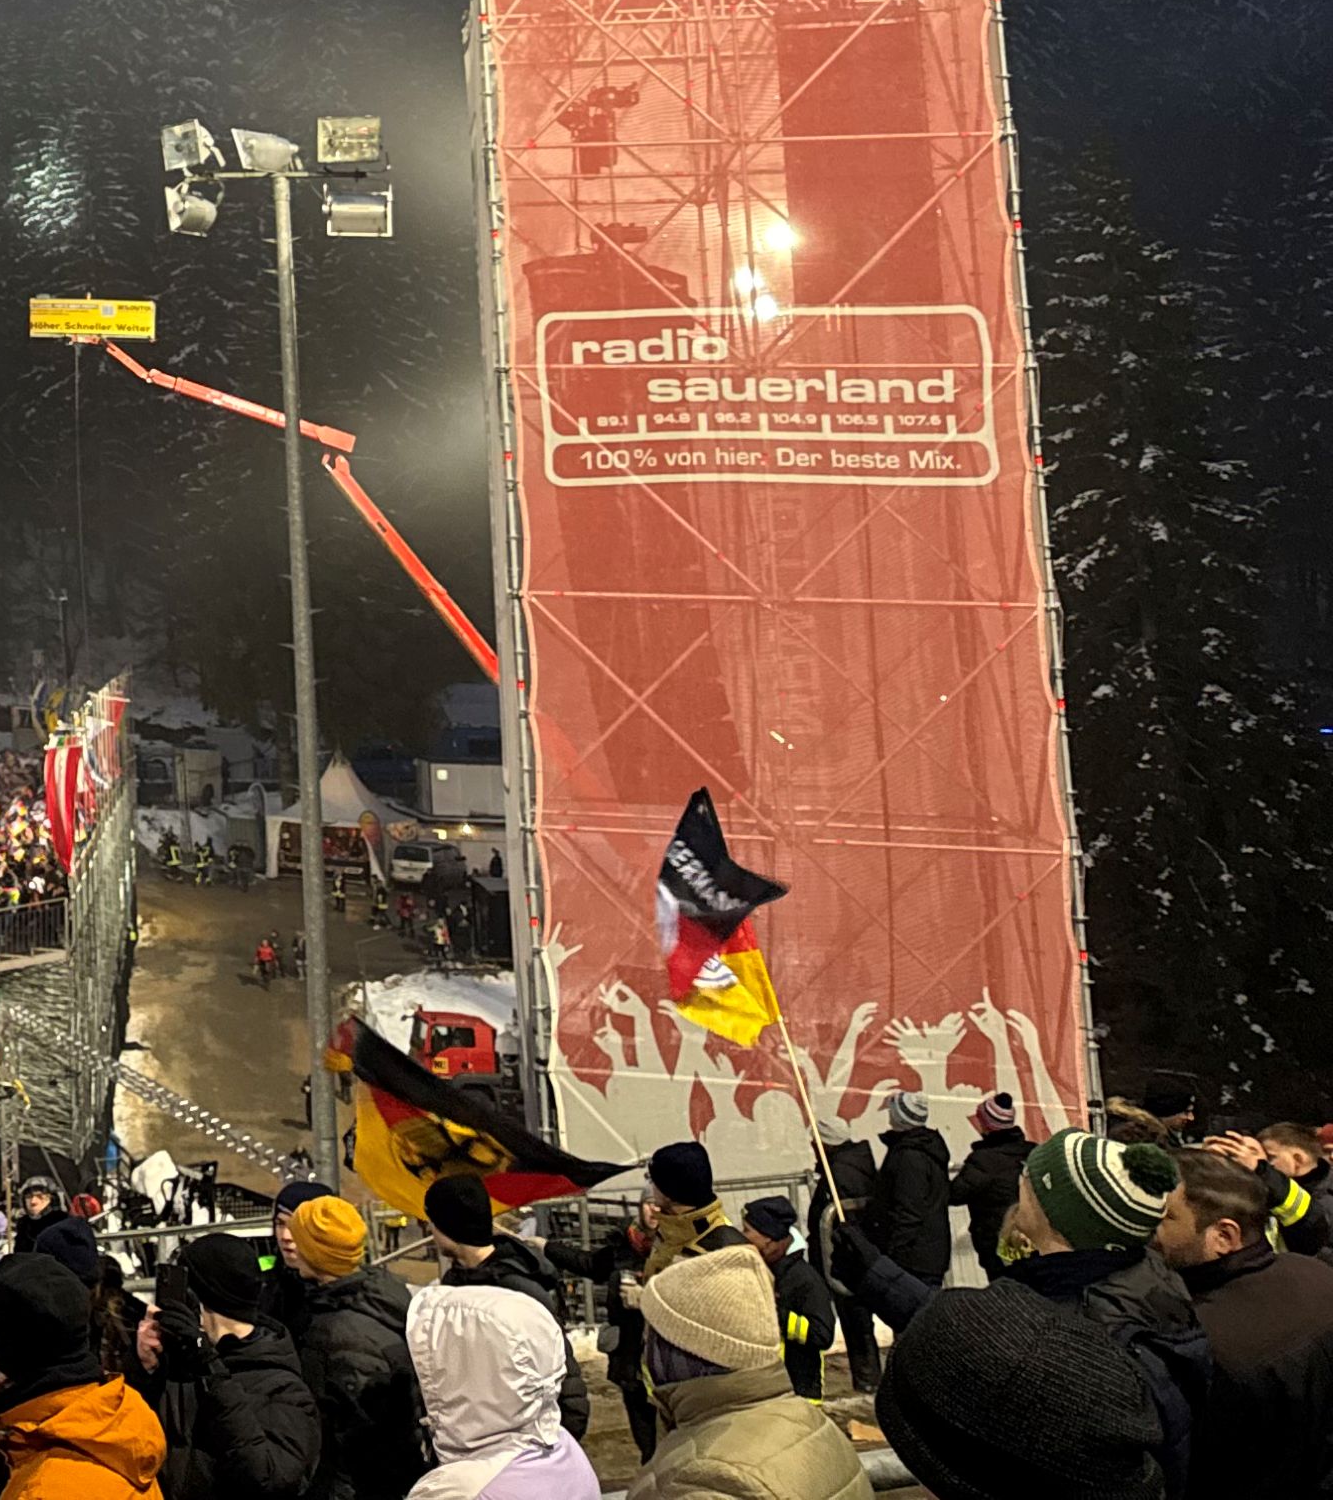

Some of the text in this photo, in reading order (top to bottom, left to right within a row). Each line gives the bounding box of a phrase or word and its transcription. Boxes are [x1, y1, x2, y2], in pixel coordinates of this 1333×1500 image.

[571, 328, 729, 365] radio
[647, 369, 956, 405] sauerland
[596, 412, 942, 427] 89.1 94.8 96.2 104.9 106.5 107.6
[664, 453, 706, 467] von
[714, 447, 767, 467] hier.
[776, 449, 822, 467] Der
[831, 448, 900, 469] beste
[908, 450, 963, 471] Mix.
